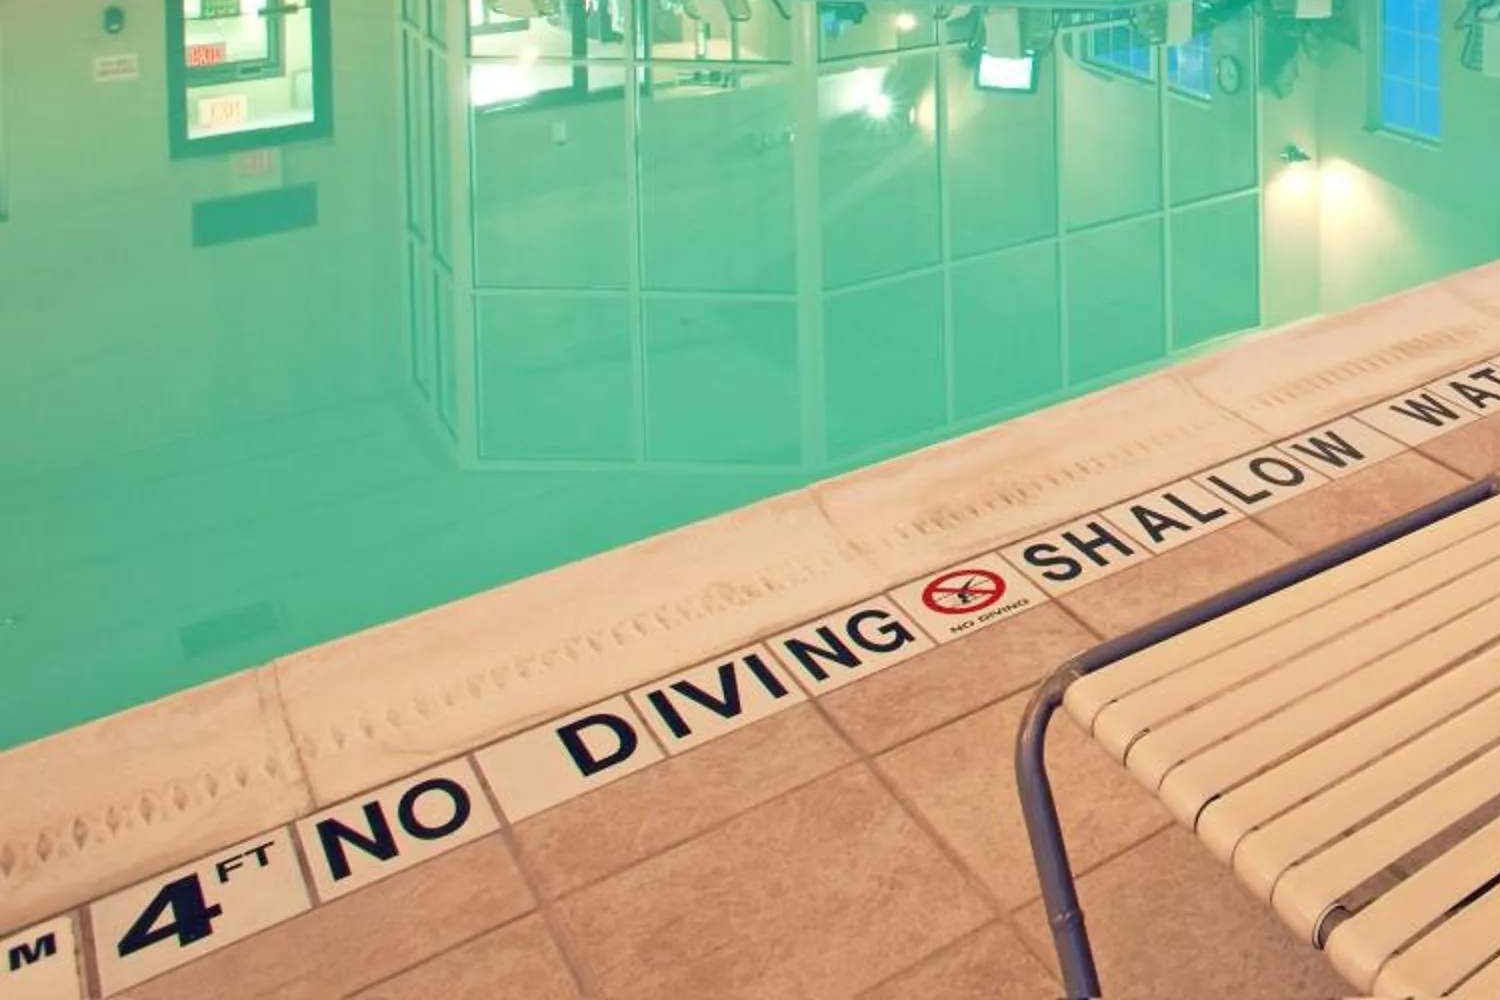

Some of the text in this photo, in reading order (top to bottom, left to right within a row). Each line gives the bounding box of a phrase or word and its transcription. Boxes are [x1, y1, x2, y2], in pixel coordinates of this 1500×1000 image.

[1022, 430, 1366, 582] SHALLOW
[977, 597, 1030, 622] DIVING
[315, 608, 916, 882] NO DIVING
[8, 840, 275, 972] M 4 FT
